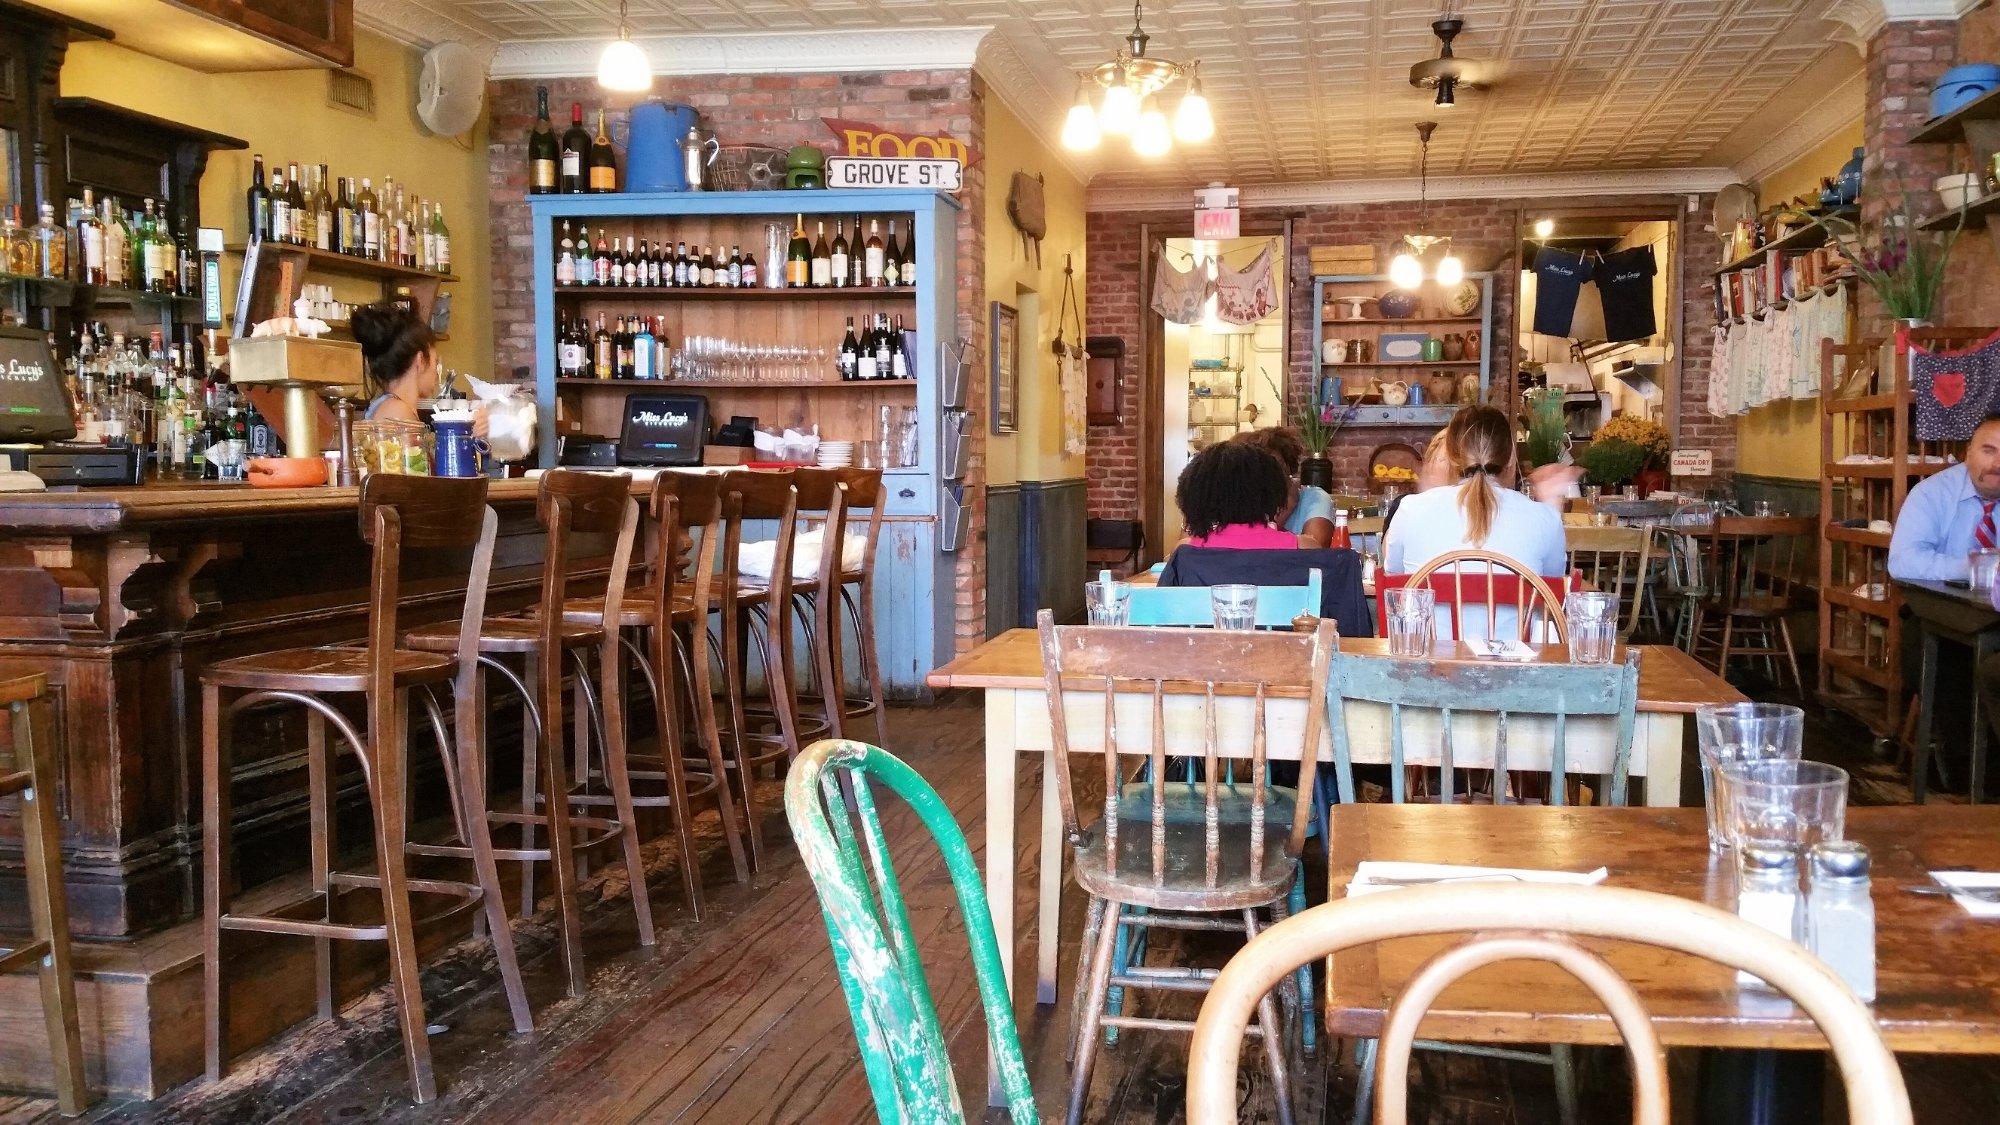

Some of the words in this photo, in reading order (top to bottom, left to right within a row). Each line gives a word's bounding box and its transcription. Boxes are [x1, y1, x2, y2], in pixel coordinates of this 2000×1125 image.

[844, 129, 967, 167] FOOD
[844, 163, 909, 185] GROVE
[919, 164, 947, 185] ST.
[1203, 212, 1232, 235] EXIT
[8, 359, 44, 381] Lucy's
[632, 411, 660, 423] Miss
[660, 411, 689, 427] Lucy's
